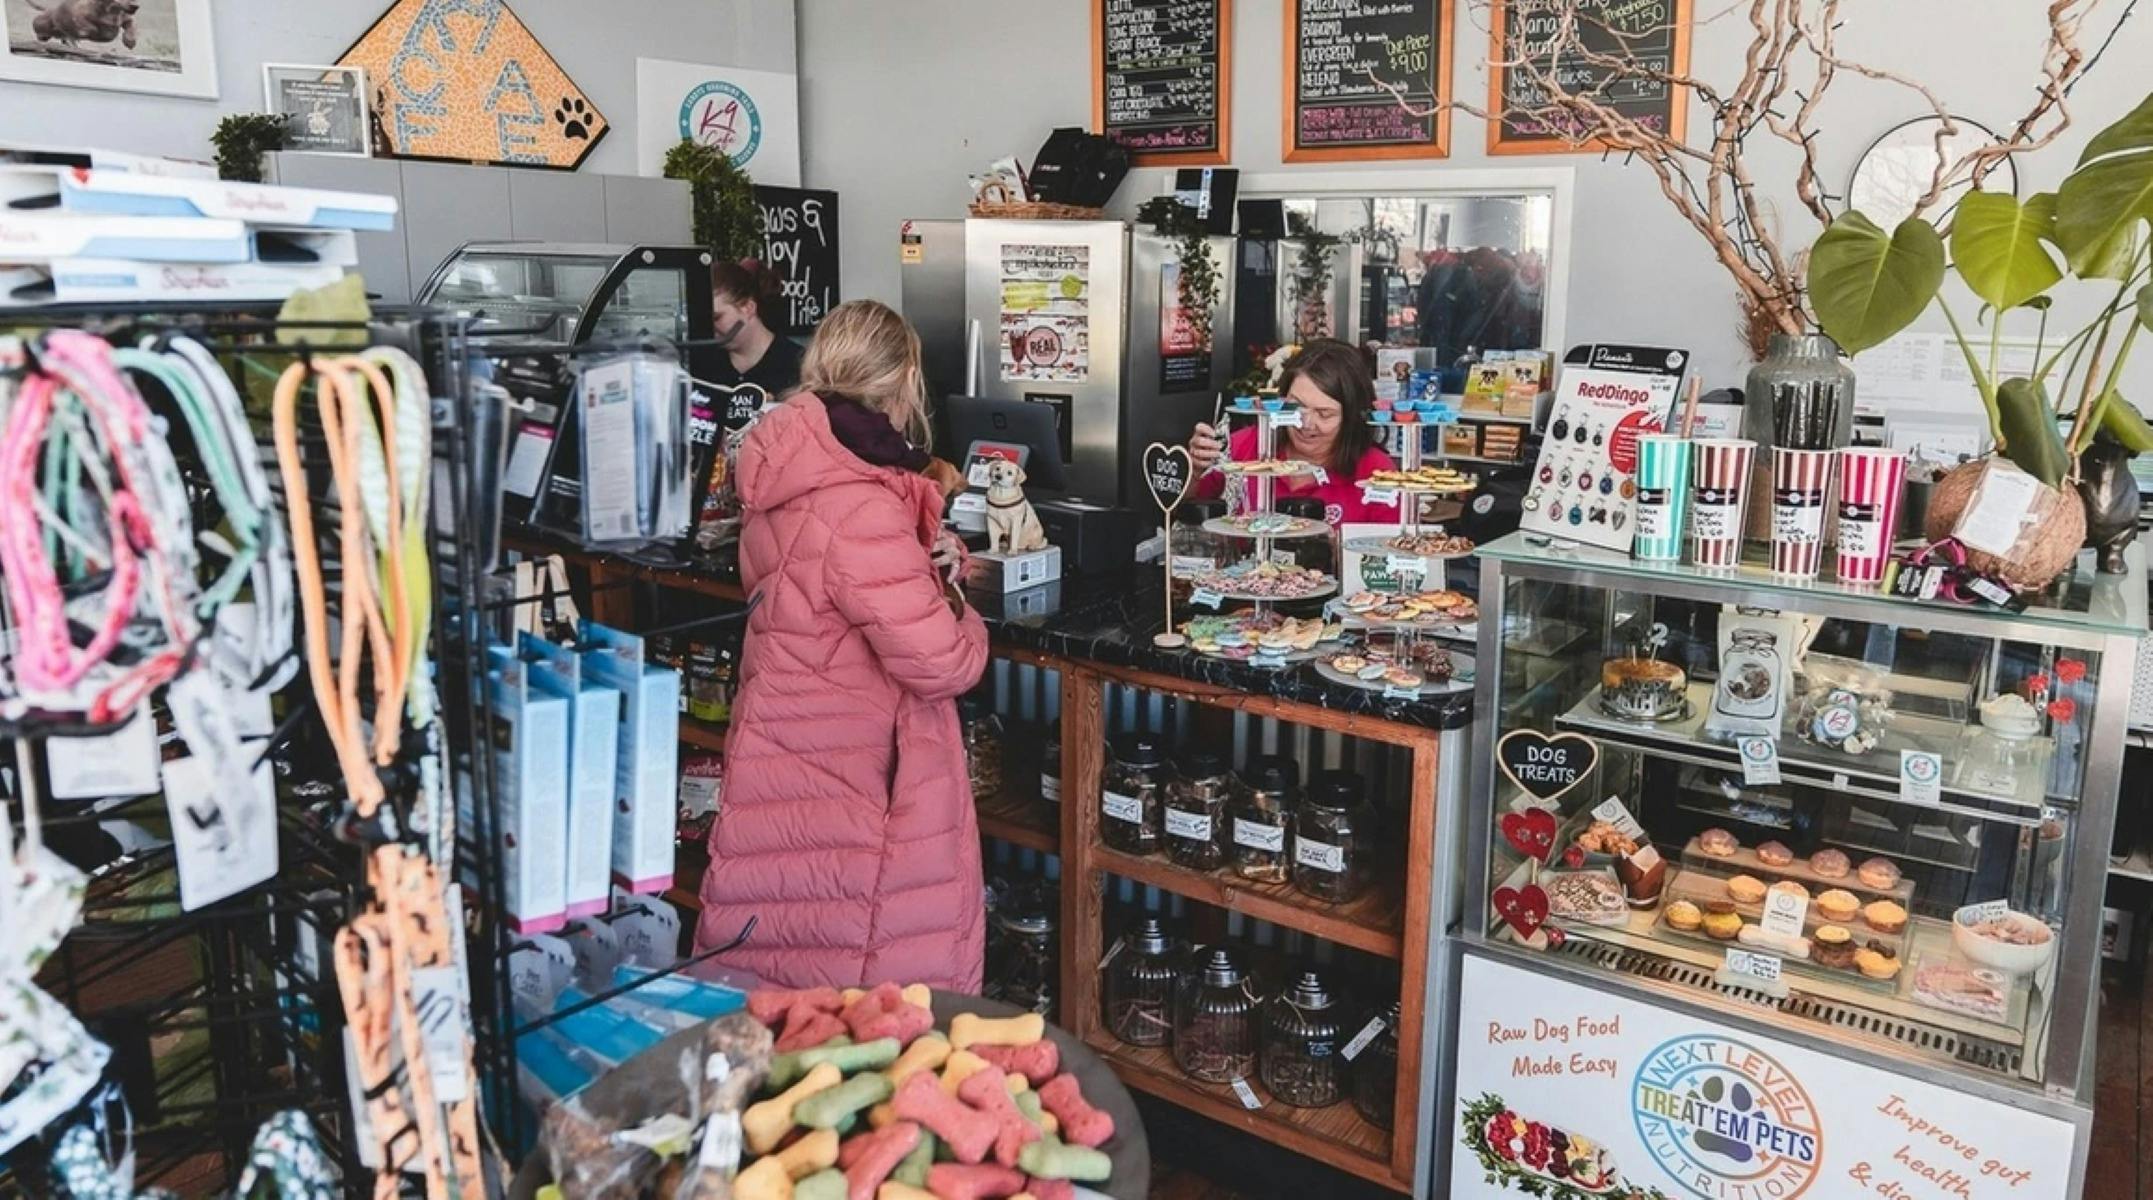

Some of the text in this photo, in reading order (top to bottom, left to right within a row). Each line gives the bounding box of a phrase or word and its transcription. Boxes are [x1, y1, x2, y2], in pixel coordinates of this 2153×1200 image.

[699, 99, 739, 136] K9
[1577, 382, 1649, 406] RedDingo
[1156, 458, 1179, 477] DOG
[1151, 474, 1184, 495] TREATS
[1526, 745, 1567, 764] DOG
[1513, 763, 1577, 784] TREATS
[1488, 1014, 1620, 1044] Raw Dog Food
[1512, 1053, 1618, 1079] Made Easy
[1649, 1042, 1806, 1122] NEXT LEVEL
[1641, 1084, 1815, 1162] TREAT'EM PETS
[1876, 1093, 2033, 1187] Improve gut
[1644, 1121, 1803, 1200] NUTRITION
[1848, 1161, 1873, 1188] &
[1893, 1144, 1974, 1200] health
